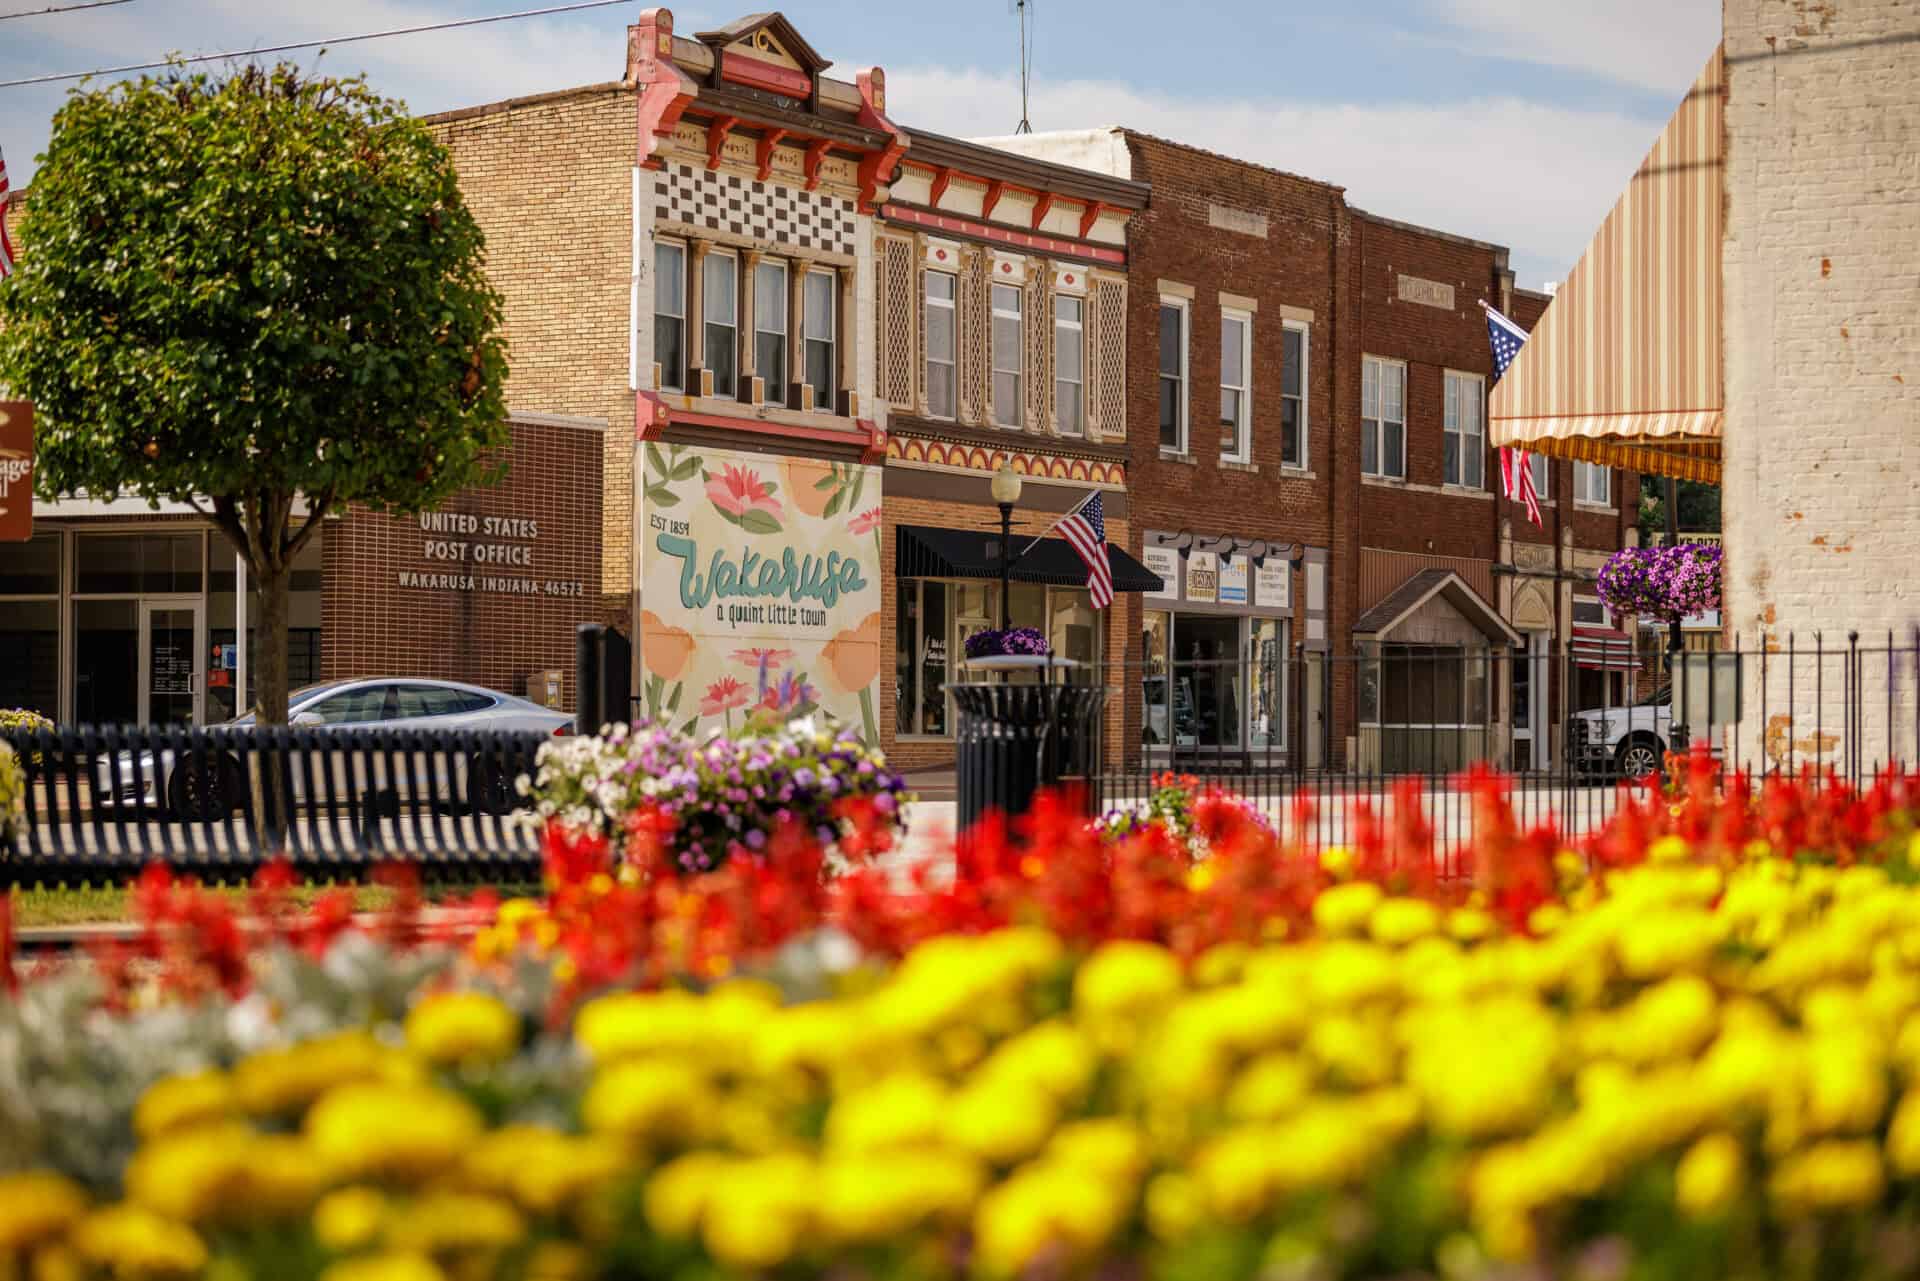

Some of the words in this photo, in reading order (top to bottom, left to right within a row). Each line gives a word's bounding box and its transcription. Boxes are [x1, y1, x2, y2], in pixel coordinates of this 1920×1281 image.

[420, 512, 478, 533] UNITED
[483, 517, 537, 538] STATES
[650, 514, 666, 531] EST
[670, 520, 690, 536] 1859
[424, 541, 467, 561] POST
[473, 544, 532, 565] OFFICE
[399, 571, 475, 590] WAKARUSA
[482, 577, 538, 594] INDIANA
[544, 581, 583, 596] 46573
[657, 533, 867, 609] Wakarusa
[717, 605, 723, 620] a
[729, 603, 764, 629] quaint
[768, 604, 797, 625] little
[801, 608, 826, 626] town
